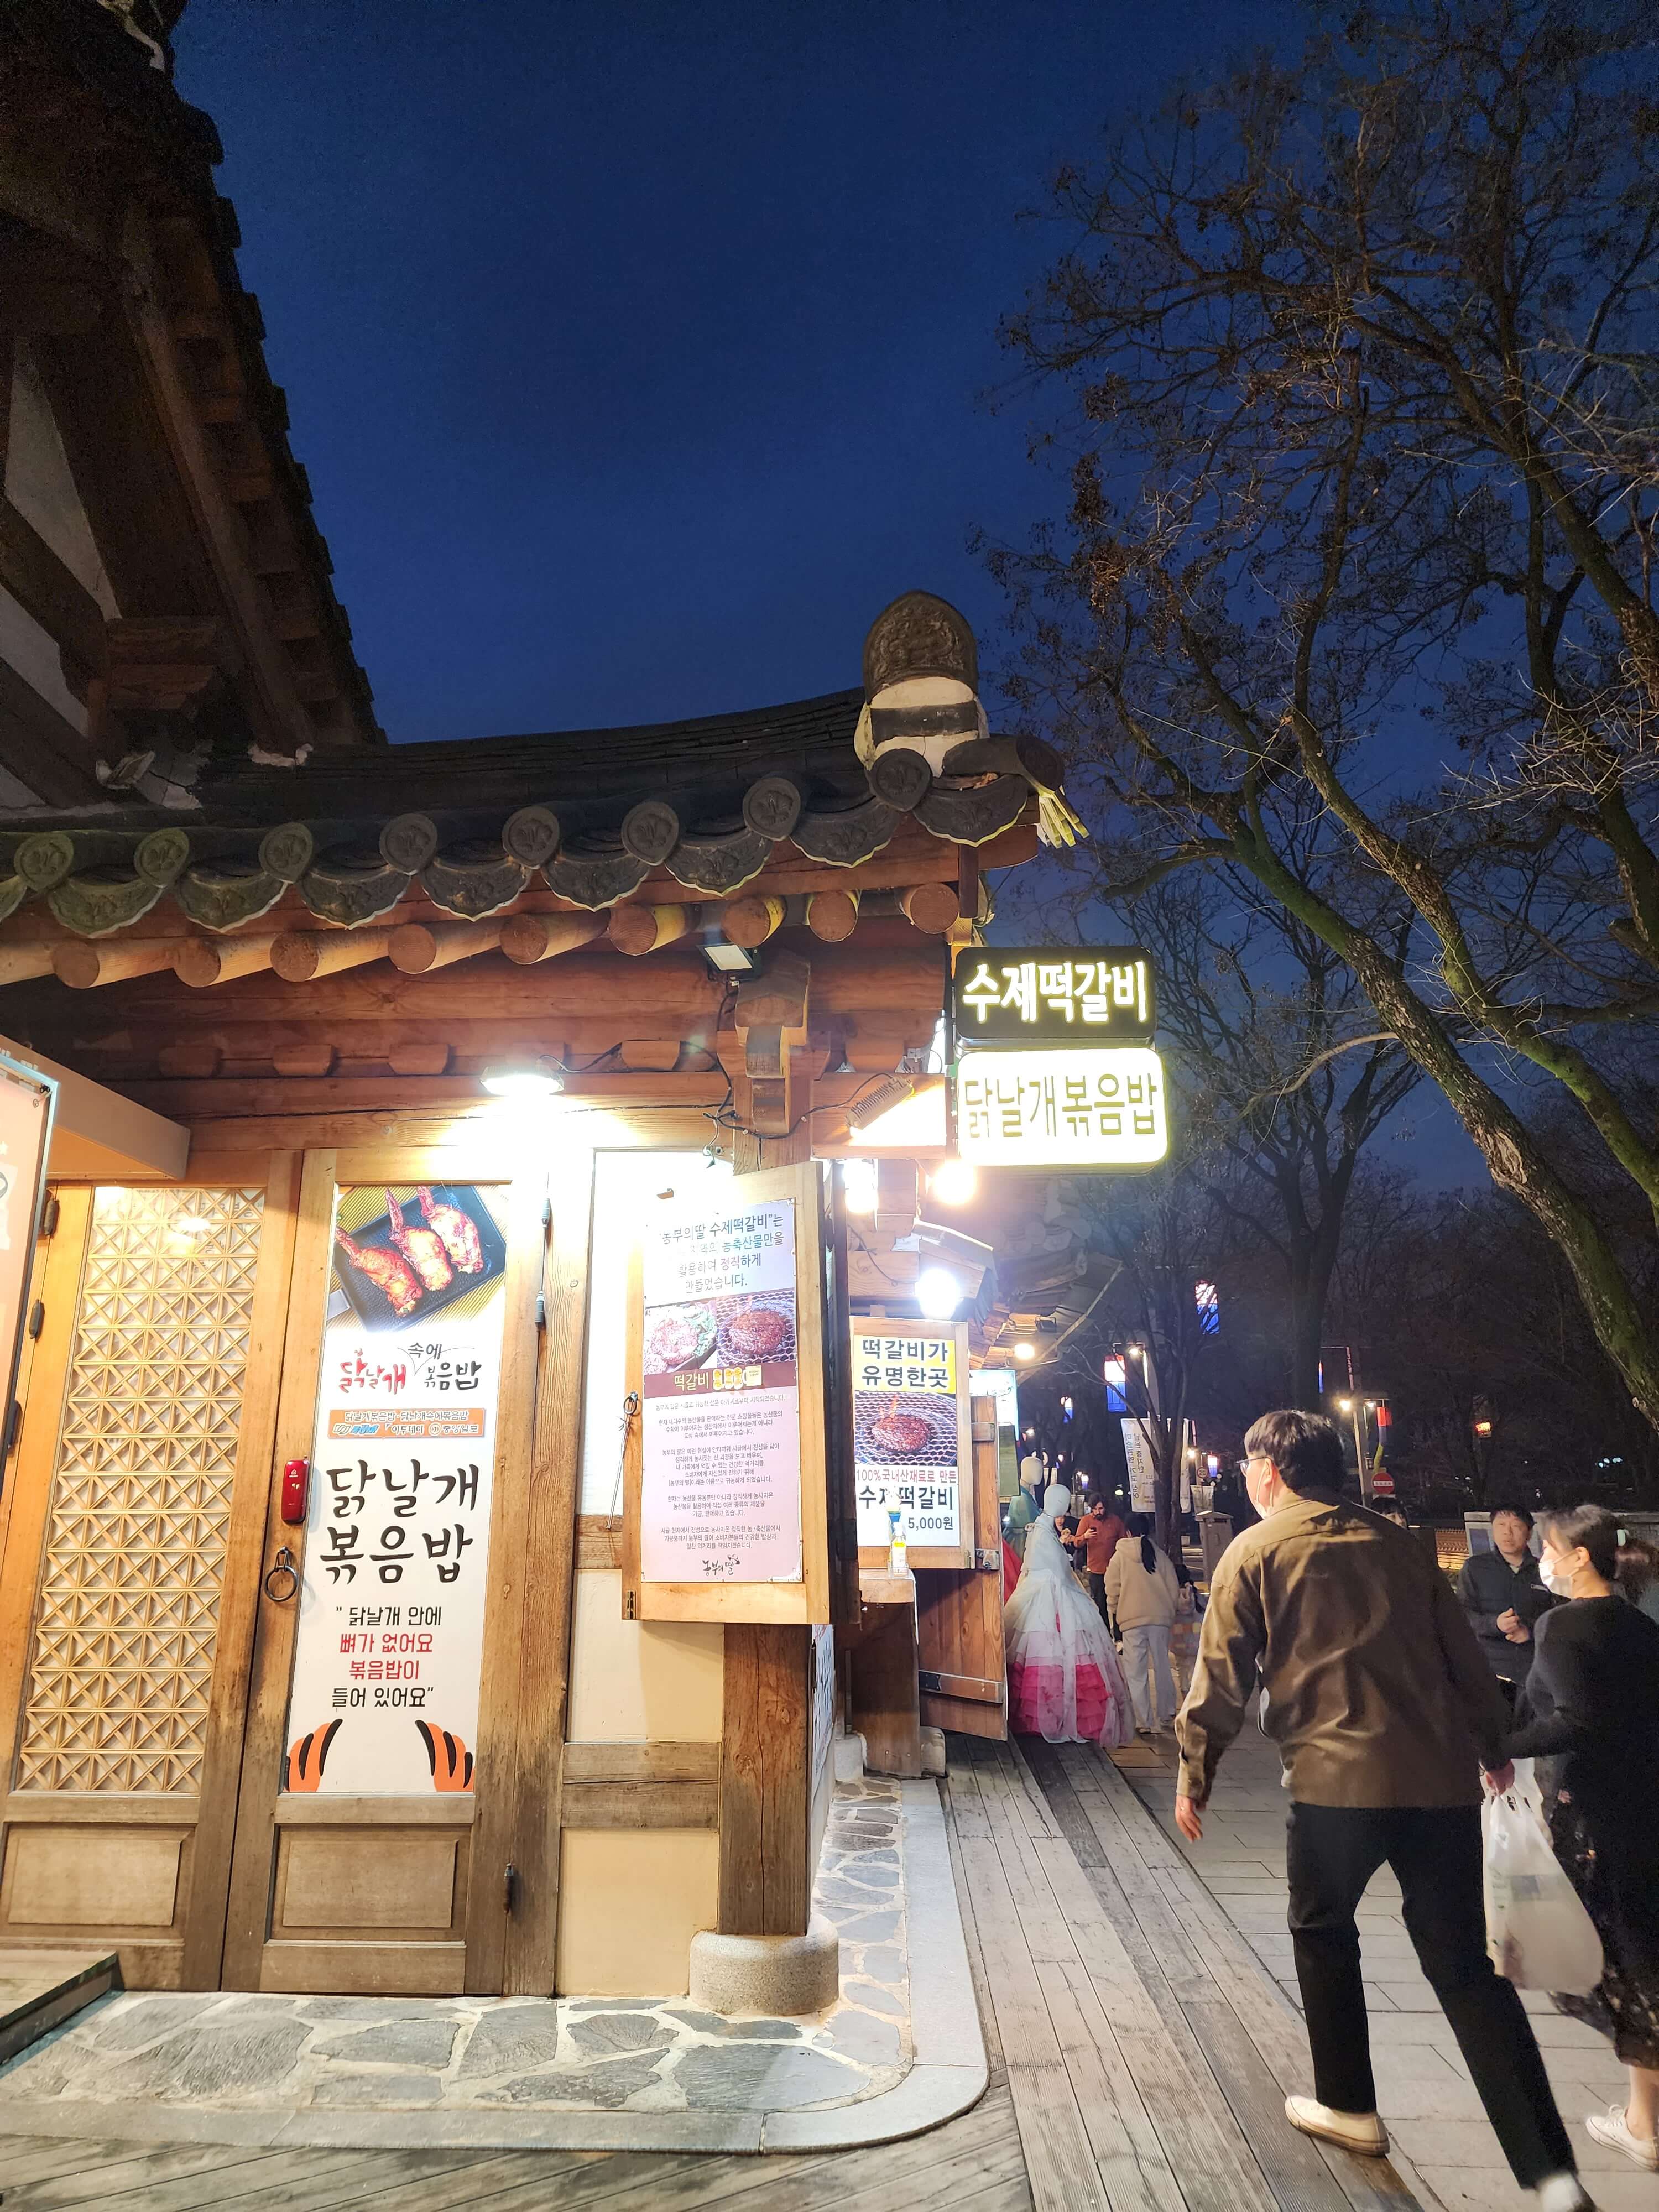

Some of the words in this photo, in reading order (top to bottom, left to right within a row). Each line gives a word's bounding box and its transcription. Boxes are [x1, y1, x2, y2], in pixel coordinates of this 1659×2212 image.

[962, 961, 1147, 1024] 수제떡갈비
[964, 1073, 1157, 1138] 닭날개볶음밥
[722, 1230, 784, 1253] 농축산물만을
[721, 1253, 761, 1270] 정직하게
[685, 1273, 748, 1293] 만들었습니다.
[408, 1343, 442, 1359] 속에
[862, 1339, 948, 1362] 떡갈비가
[339, 1358, 406, 1394] 닭날개
[424, 1361, 482, 1390] 볶음밥
[674, 1371, 709, 1392] 떡갈비
[861, 1366, 948, 1388] 유명한곳
[392, 1425, 423, 1434] 이투데이
[443, 1425, 478, 1433] 중앙일보
[857, 1469, 936, 1483] 100%국내산재료로
[940, 1470, 957, 1484] 만든
[326, 1459, 479, 1519] 닭날개
[907, 1516, 954, 1531] 5,000원
[320, 1522, 473, 1585] 볶음밥
[408, 1606, 442, 1626] 안에
[340, 1633, 374, 1653] 뼈가
[382, 1633, 433, 1653] 없어요
[349, 1660, 419, 1681] 볶음밥이
[331, 1687, 366, 1708] 들어
